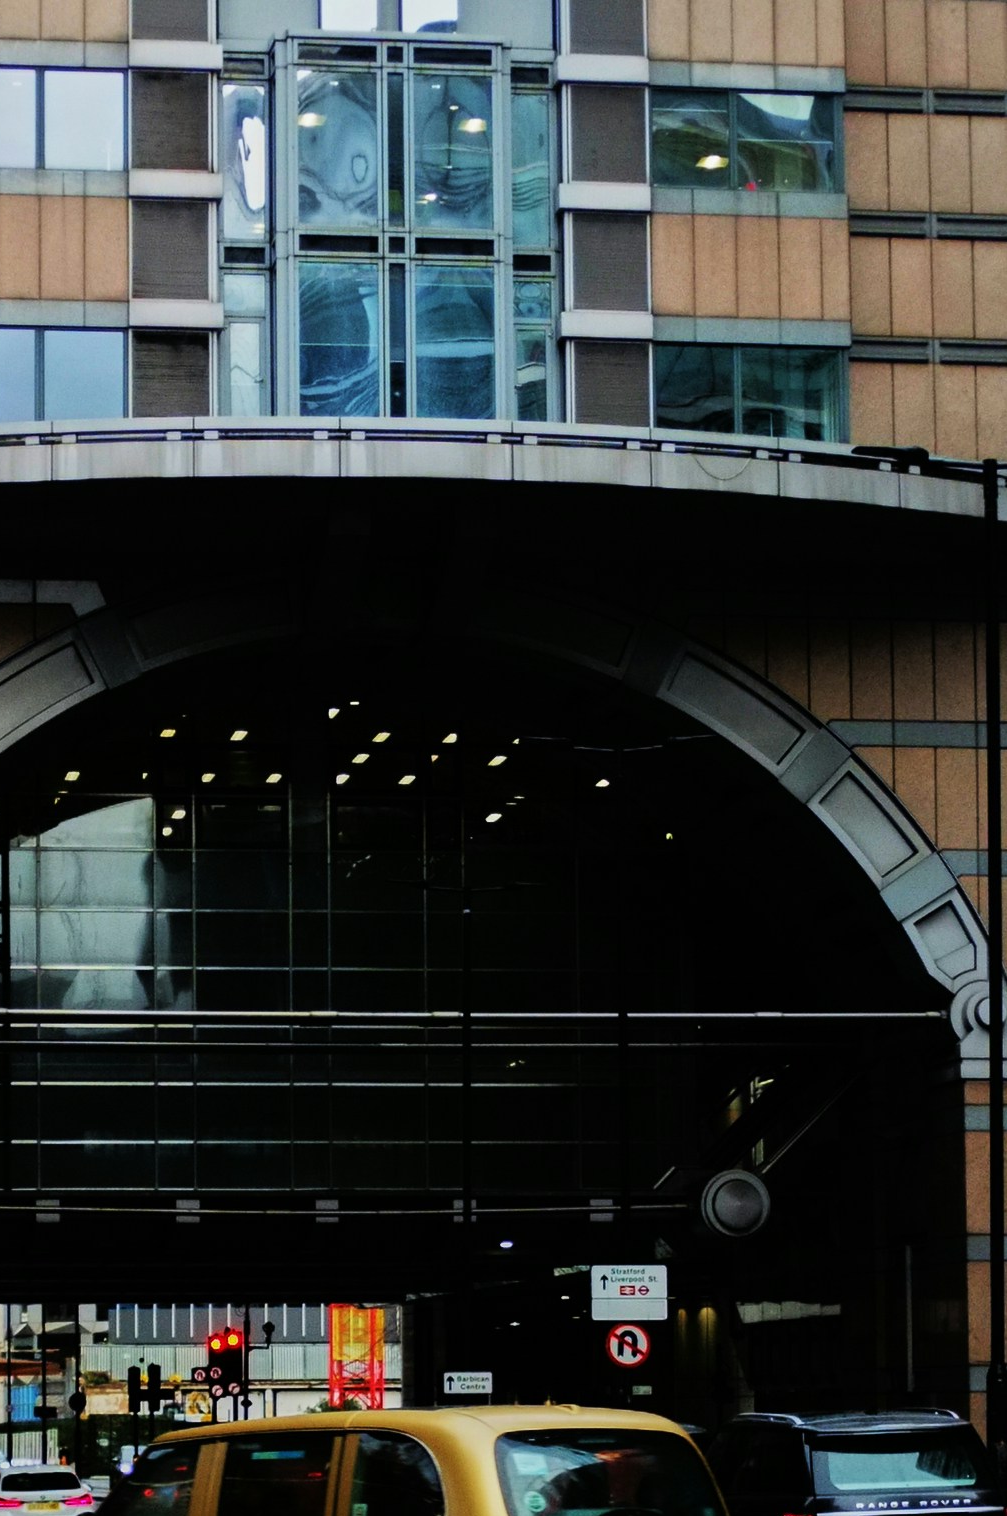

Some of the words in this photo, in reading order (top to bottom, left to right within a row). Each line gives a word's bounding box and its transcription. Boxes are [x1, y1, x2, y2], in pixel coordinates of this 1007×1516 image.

[611, 1268, 646, 1276] Stratford
[610, 1276, 645, 1284] Liverpool
[457, 1375, 490, 1383] Barbican
[460, 1383, 487, 1391] Centre
[856, 1501, 909, 1509] RANGE
[919, 1498, 972, 1507] ROVER
